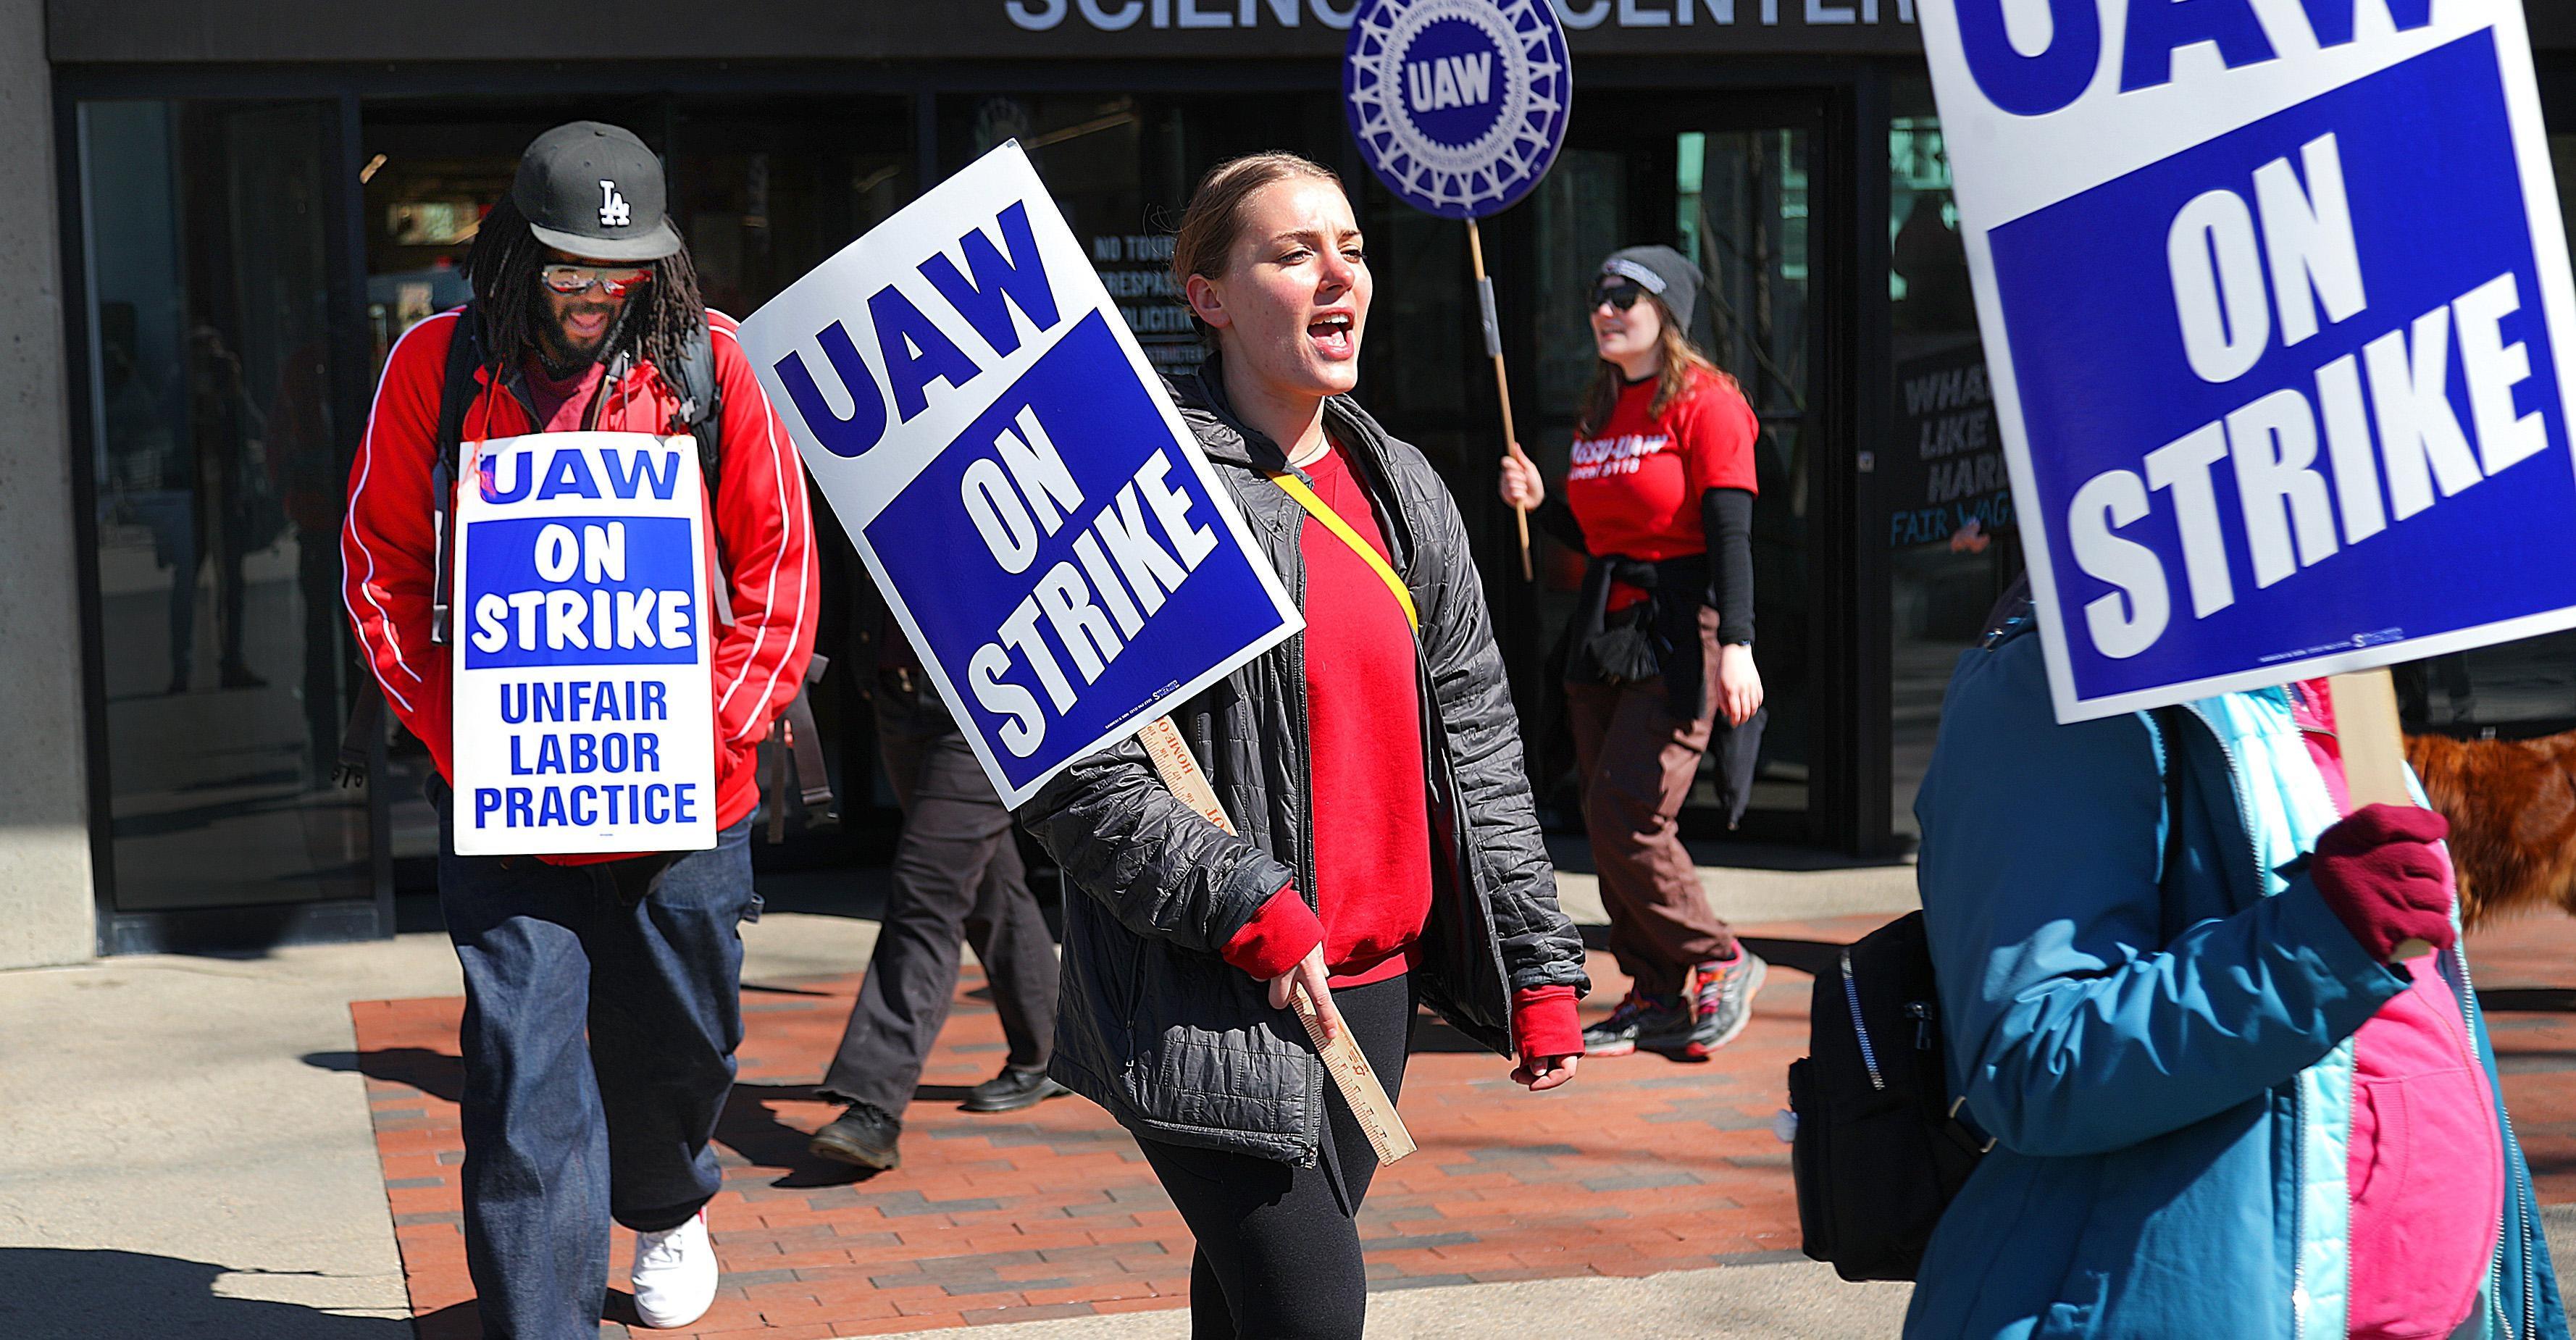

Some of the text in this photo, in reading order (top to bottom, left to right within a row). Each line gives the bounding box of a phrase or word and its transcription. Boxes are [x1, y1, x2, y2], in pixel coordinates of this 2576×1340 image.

[1407, 51, 1492, 112] UAW
[1954, 0, 2433, 117] UA
[599, 180, 631, 226] LA
[1094, 236, 1121, 261] NO
[2166, 132, 2367, 384] ON
[773, 199, 1061, 458] UAW
[1904, 364, 1992, 416] WHA
[1920, 408, 1989, 461] LIKE
[480, 449, 681, 504] UAW
[961, 403, 1085, 575] ON
[2067, 271, 2548, 659] STRIKE
[1891, 490, 2017, 547] FAIR WAG
[535, 521, 626, 584] ON
[471, 588, 693, 653] STRIKE
[968, 446, 1221, 758] STRIKE
[501, 681, 668, 724] UNFAIR
[510, 732, 661, 776] LABOR
[1165, 733, 1194, 775] HOME
[475, 783, 698, 829] PRACTICE
